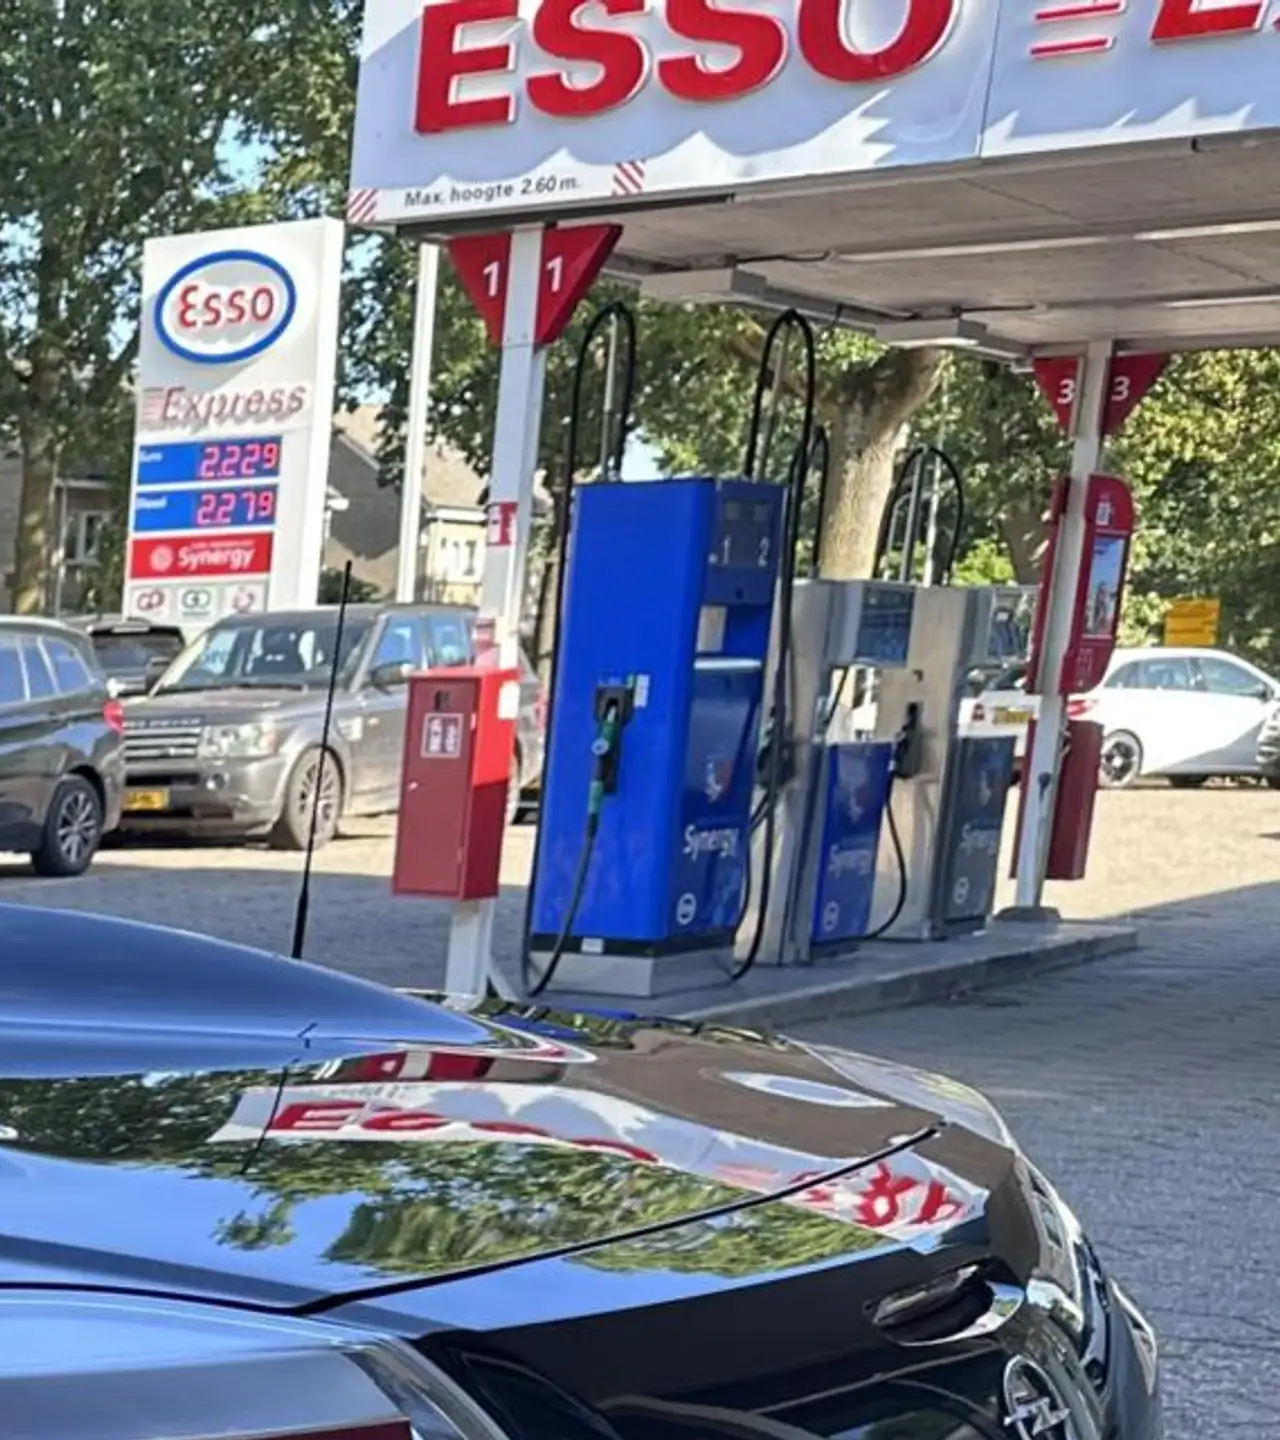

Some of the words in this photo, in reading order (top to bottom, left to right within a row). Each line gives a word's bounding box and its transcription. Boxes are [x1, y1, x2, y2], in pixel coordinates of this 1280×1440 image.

[414, 0, 958, 136] ESSO
[450, 182, 515, 203] hoogte
[483, 261, 500, 297] 1
[546, 255, 563, 293] 1
[162, 384, 308, 427] Express
[1057, 378, 1076, 405] 3
[1111, 375, 1130, 401] 3
[200, 442, 278, 478] 2.229
[177, 546, 256, 572] Synergy
[683, 823, 740, 863] Synergy
